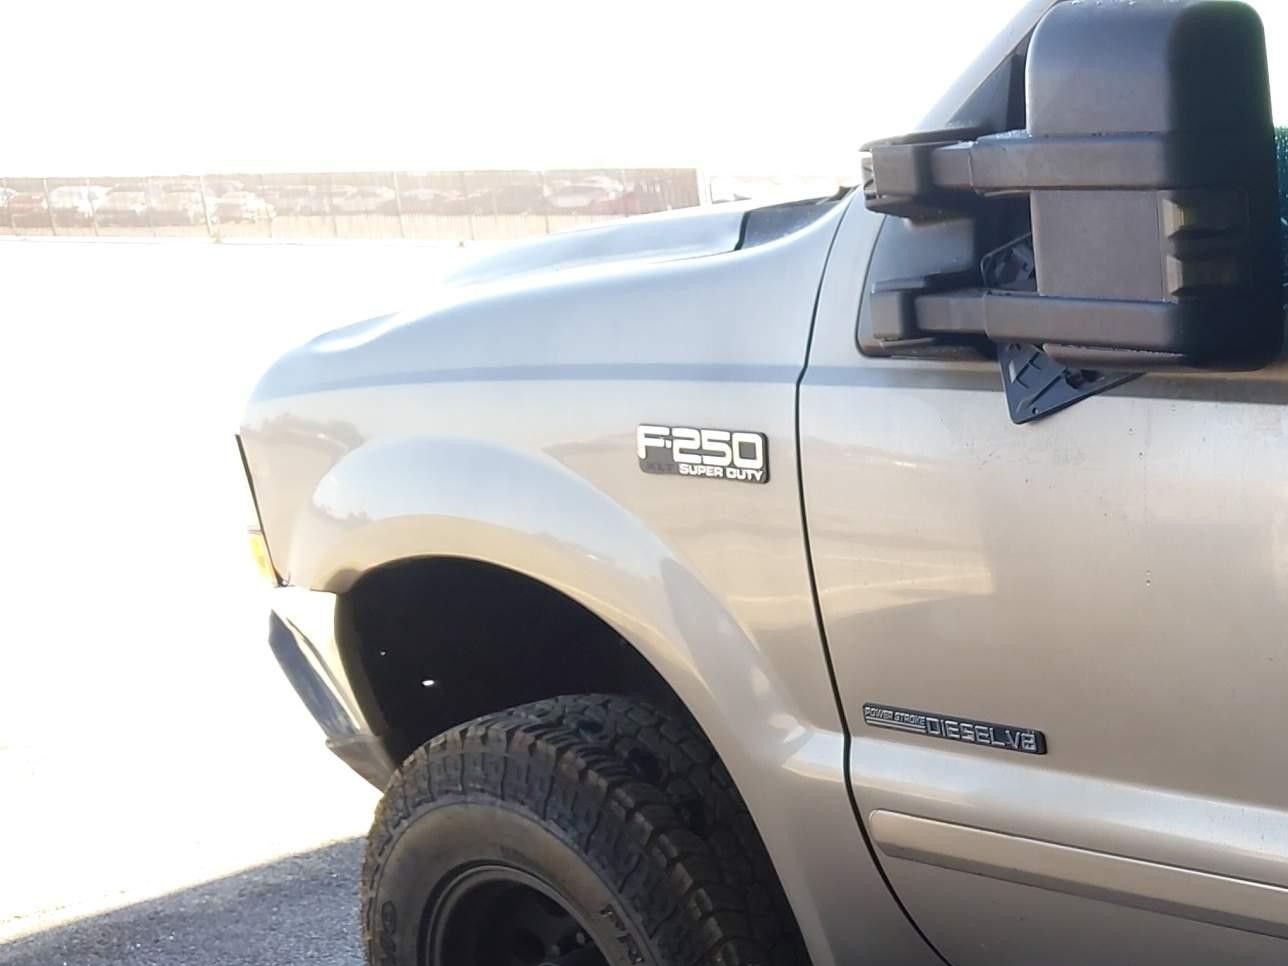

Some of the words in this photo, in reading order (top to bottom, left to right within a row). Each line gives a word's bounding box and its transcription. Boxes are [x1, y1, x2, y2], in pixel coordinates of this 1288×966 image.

[637, 425, 763, 469] F-250
[679, 464, 723, 477] SUPER
[726, 469, 763, 481] DUTY
[865, 707, 893, 719] POWER
[895, 712, 925, 725] STROKE
[926, 717, 1005, 746] DIESEL
[1005, 730, 1037, 750] V8
